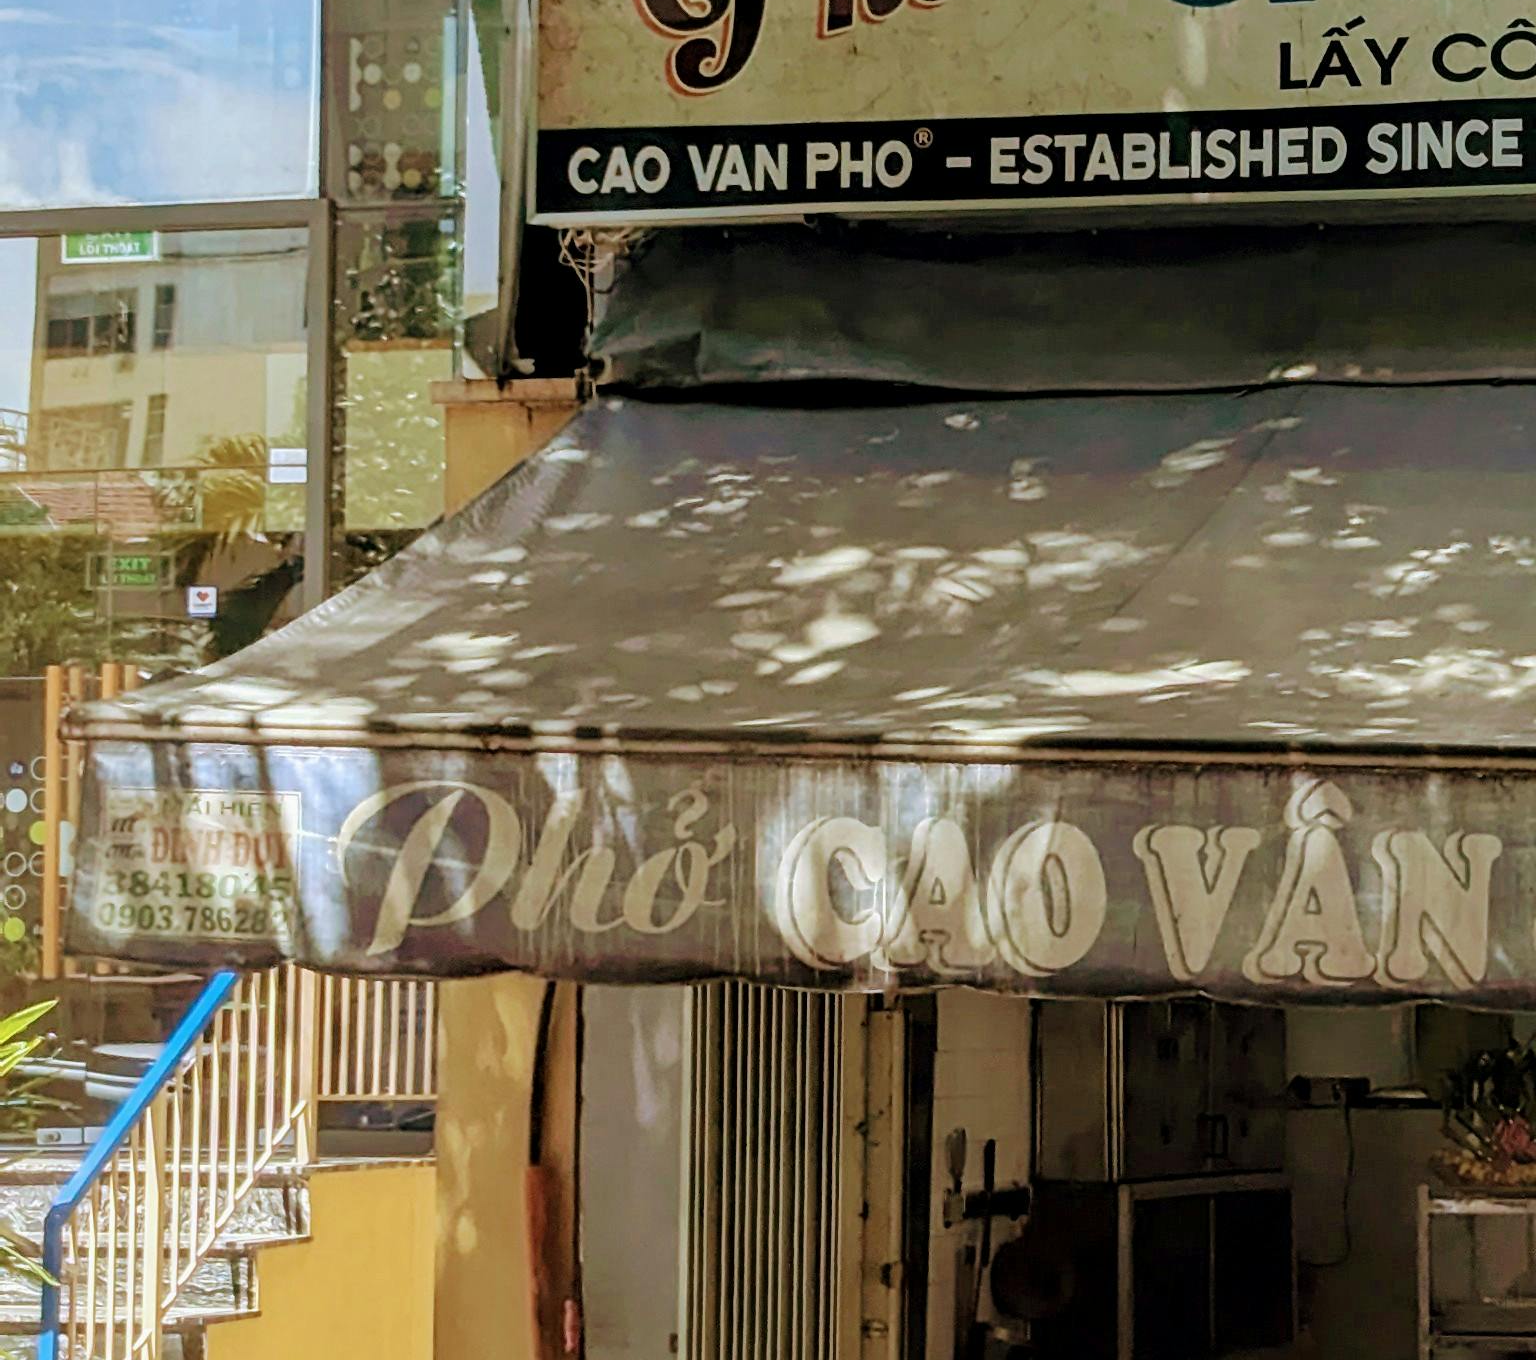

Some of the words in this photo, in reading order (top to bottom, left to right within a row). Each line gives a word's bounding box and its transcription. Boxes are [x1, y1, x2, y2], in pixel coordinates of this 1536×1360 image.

[1278, 15, 1410, 90] LẤY
[567, 146, 671, 195] CAO
[686, 143, 789, 192] VAN
[989, 127, 1348, 186] ESTABLISHED
[1366, 117, 1523, 175] SINCE
[774, 816, 1107, 978] CAO
[1131, 778, 1502, 990] VÂN
